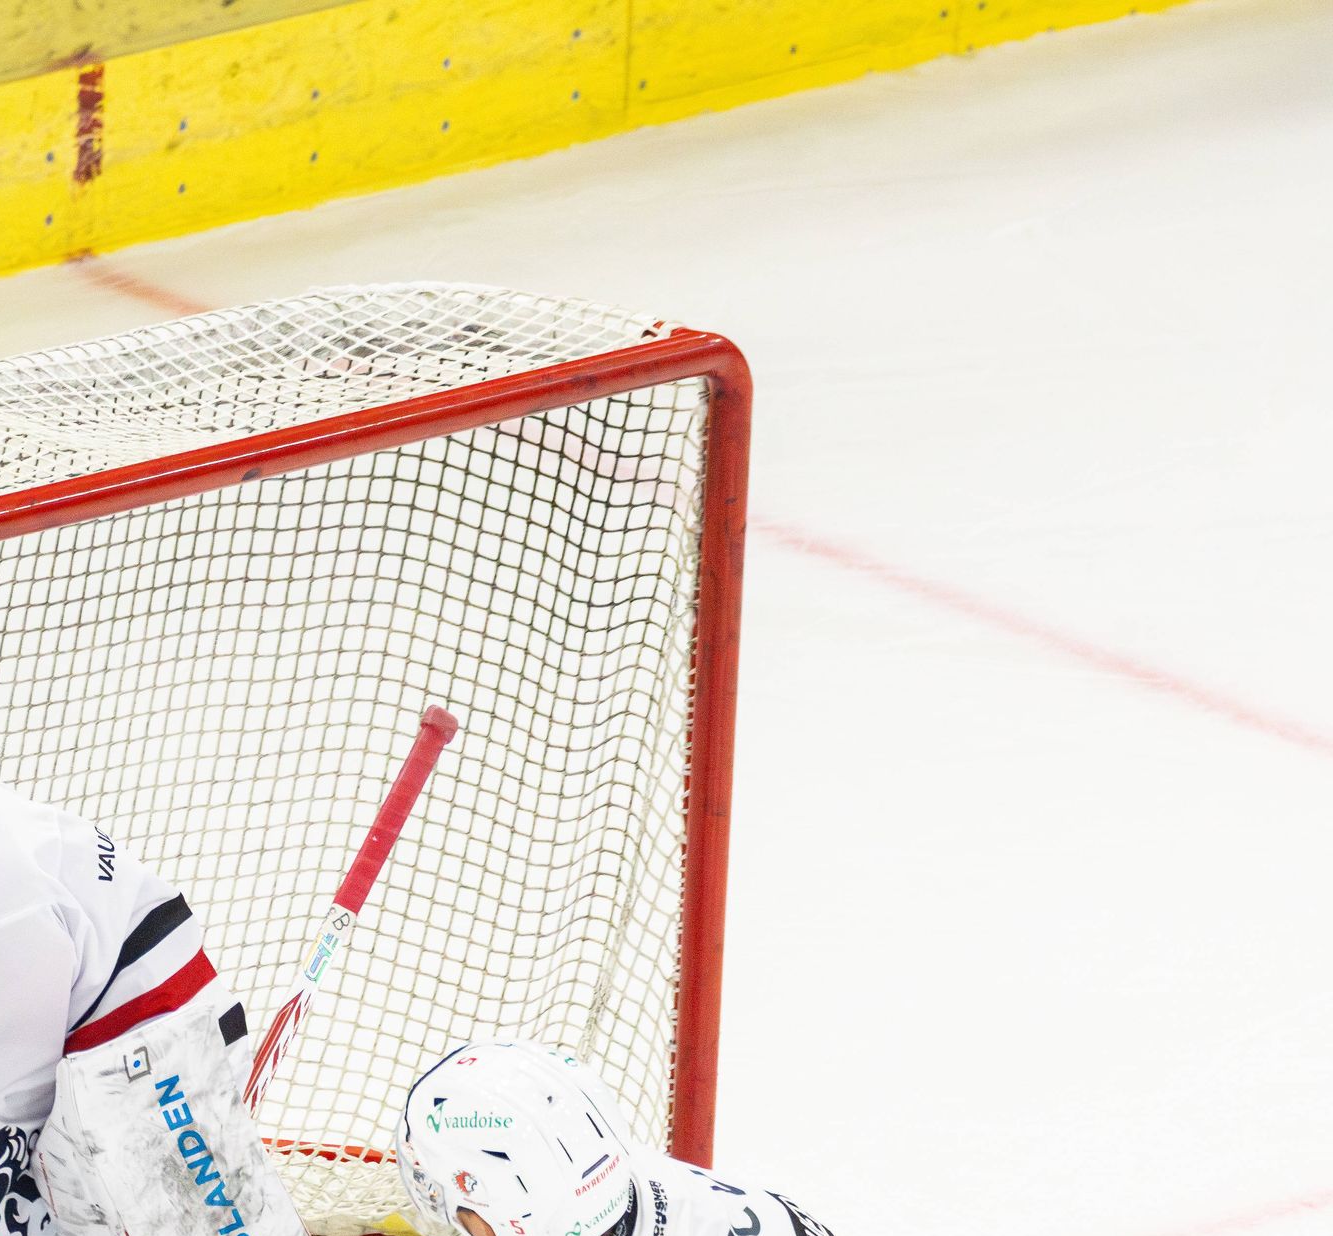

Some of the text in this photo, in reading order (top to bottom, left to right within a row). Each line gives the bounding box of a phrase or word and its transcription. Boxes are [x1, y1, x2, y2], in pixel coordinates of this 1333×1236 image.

[94, 826, 116, 882] VAU
[444, 1111, 513, 1130] vaudoise
[510, 1220, 526, 1235] 5
